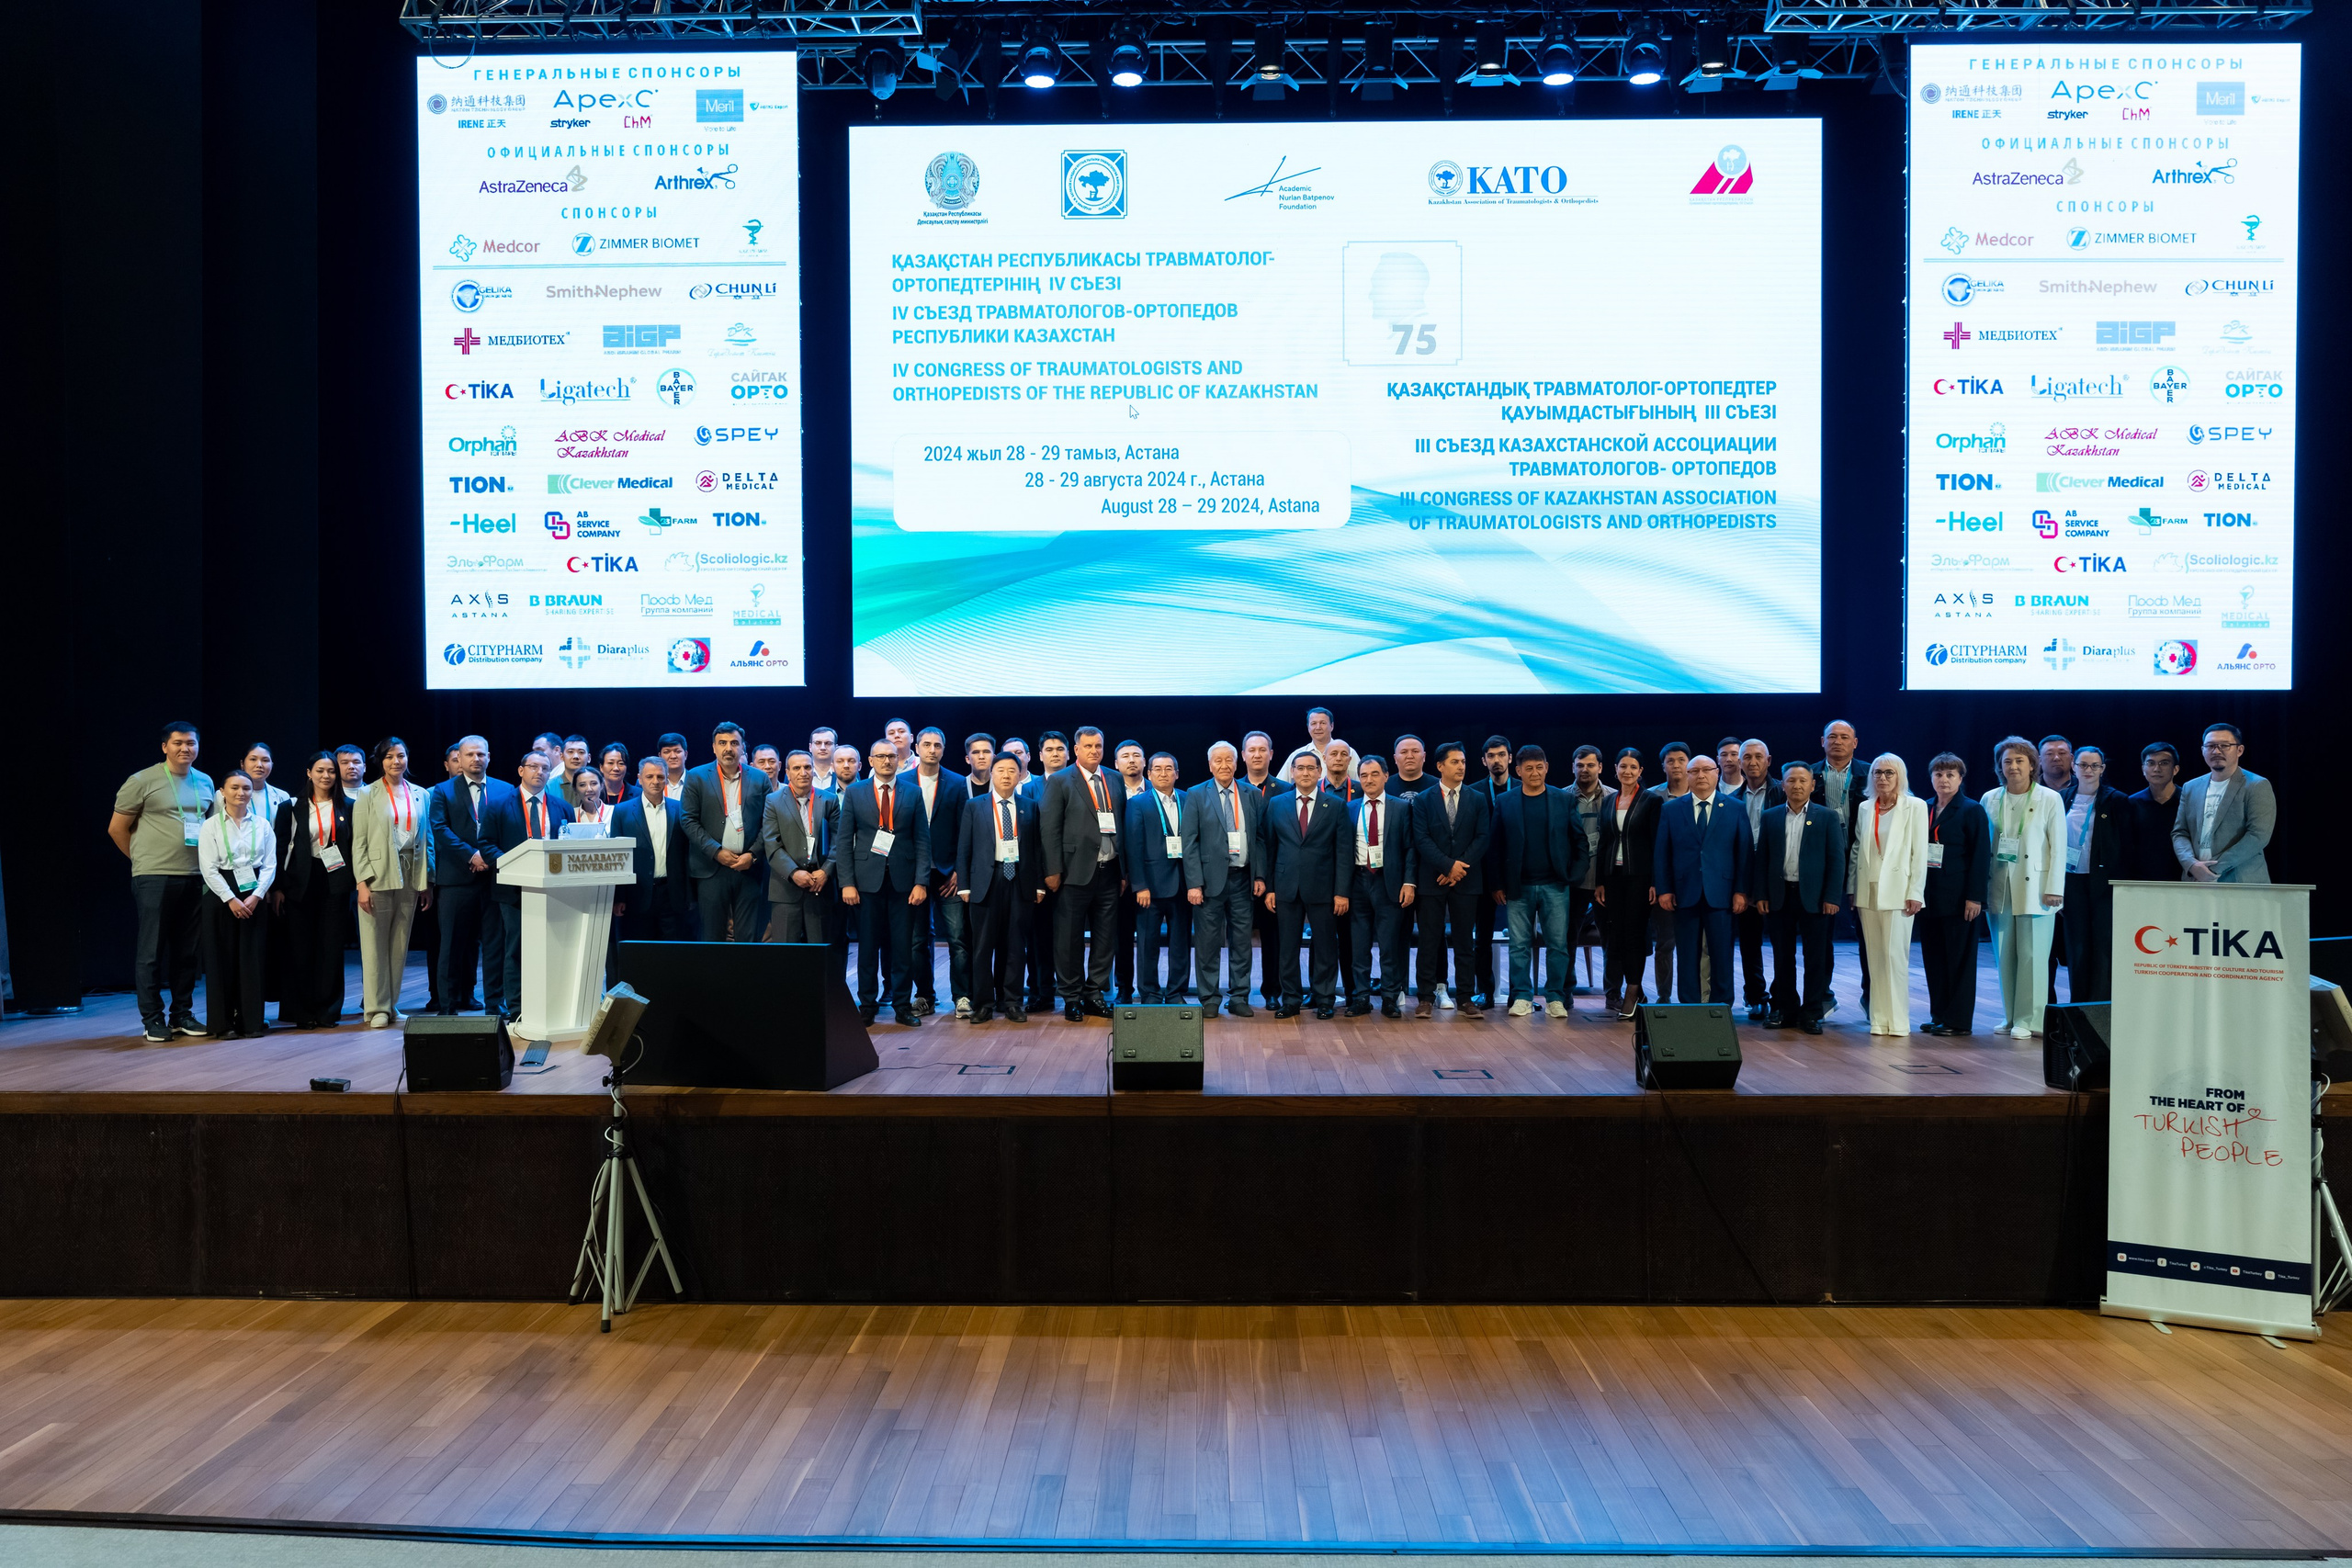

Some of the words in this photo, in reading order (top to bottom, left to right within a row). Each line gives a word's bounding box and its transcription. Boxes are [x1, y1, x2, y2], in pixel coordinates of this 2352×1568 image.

[474, 68, 619, 80] ГЕНЕРАЛЬНЫЕ
[628, 67, 740, 78] СПОНСОРЫ
[451, 95, 525, 108] 纳通科技集团
[704, 97, 736, 114] Meril
[458, 119, 484, 129] IRENE
[487, 119, 505, 128] 正天
[550, 118, 591, 129] stryker
[1982, 138, 2122, 152] ОФИЦИАЛЬНЫЕ
[2132, 138, 2228, 149] СПОНСОРЫ
[480, 180, 568, 193] AstraZeneca
[655, 173, 715, 189] Arthrex
[1467, 166, 1567, 194] KATO
[1973, 173, 2063, 185] AstraZeneca
[2056, 201, 2153, 212] СПОНСОРЫ
[2095, 233, 2143, 243] ZIMMER
[2149, 233, 2197, 243] BIOMET
[483, 240, 540, 253] Medcor
[892, 254, 992, 271] ҚАЗАҚСТАН
[999, 253, 1140, 267] РЕСПУБЛИКАСЫ
[1146, 252, 1274, 265] ТРАВМАТОЛОГ-
[478, 286, 512, 295] GELIKA
[892, 277, 1041, 295] ОРТОПЕДТЕРІНІҢ
[1050, 276, 1066, 290] IV
[1070, 276, 1121, 290] СЪЕЗІ
[893, 306, 909, 320] IV
[914, 306, 972, 322] СЪЕЗД
[976, 303, 1238, 321] ТРАВМАТОЛОГОВ-ОРТОПЕДОВ
[488, 335, 565, 346] МЕДБИОТЕХ
[893, 329, 1009, 344] РЕСПУБЛИКИ
[1014, 328, 1114, 343] КАЗАХСТАН
[1391, 322, 1437, 355] 75
[893, 364, 909, 377] IV
[914, 362, 1005, 377] CONGRESS
[1011, 362, 1032, 376] OF
[1036, 361, 1202, 376] TRAUMATOLOGISTS
[1207, 360, 1242, 375] AND
[2226, 367, 2282, 380] САЙГАК
[540, 378, 630, 405] Ligatech
[661, 383, 693, 393] BAYER
[893, 386, 1021, 400] ORTHOPEDISTS
[1026, 386, 1047, 400] OF
[1053, 386, 1085, 400] THE
[1091, 385, 1173, 400] REPUBLIC
[1179, 385, 1200, 399] OF
[1206, 384, 1317, 399] KAZAKHSTAN
[1387, 382, 1530, 400] ҚАЗАҚСТАНДЫҚ
[1533, 381, 1776, 398] ТРАВМАТОЛОГ-ОРТОПЕДТЕР
[2225, 384, 2283, 398] ОРТО
[1502, 405, 1697, 423] ҚАУЫМДАСТЫҒЫНЫҢ
[1705, 405, 1720, 419] III
[1725, 405, 1776, 419] СЪЕЗІ
[716, 428, 778, 441] SPEY
[2105, 428, 2157, 439] Medical
[1416, 439, 1430, 453] III
[1436, 438, 1495, 456] СЪЕЗД
[1499, 434, 1647, 452] КАЗАХСТАНСКОЙ
[1653, 437, 1776, 455] АССОЦИАЦИИ
[1937, 434, 2006, 453] Orphan
[2047, 445, 2120, 456] Kazakhstan
[924, 446, 962, 461] 2024
[967, 449, 1001, 460] жыл
[1007, 446, 1024, 460] 28
[1042, 446, 1059, 460] 29
[1065, 448, 1120, 462] тамыз,
[1125, 445, 1179, 459] Астана
[1510, 461, 1666, 476] ТРАВМАТОЛОГОВ-
[1672, 461, 1776, 479] ОРТОПЕДОВ
[2215, 473, 2270, 481] DELTA
[1025, 472, 1044, 487] 28
[1060, 472, 1079, 487] 29
[1084, 475, 1142, 491] августа
[1148, 471, 1186, 486] 2024
[1192, 475, 1205, 489] г.,
[1210, 471, 1264, 486] Астана
[1936, 473, 1993, 491] TION
[2058, 475, 2105, 488] Clever
[2108, 477, 2164, 488] Medical
[1400, 492, 1415, 506] III
[1420, 492, 1512, 506] CONGRESS
[1518, 491, 1540, 505] OF
[1544, 491, 1656, 505] KAZAKHSTAN
[1663, 491, 1777, 505] ASSOCIATION
[1102, 499, 1153, 517] August
[1159, 498, 1177, 513] 28
[1198, 498, 1216, 513] 29
[1222, 498, 1263, 515] 2024,
[1269, 498, 1319, 513] Astana
[1409, 516, 1430, 530] OF
[1437, 515, 1601, 530] TRAUMATOLOGISTS
[1607, 514, 1642, 528] AND
[1647, 514, 1777, 529] ORTHOPEDISTS
[2188, 553, 2278, 568] Scoliologic.kz
[529, 595, 540, 606] B
[546, 594, 602, 606] BRAUN
[469, 645, 542, 655] CITYPHARM
[568, 853, 629, 863] NAZARBAYEV
[568, 863, 625, 872] UNIVERSITY
[2184, 922, 2283, 959] TİKA
[2206, 1088, 2245, 1100] FROM
[2150, 1096, 2175, 1108] THE
[2177, 1098, 2223, 1112] HEART
[2226, 1102, 2245, 1113] OF
[2133, 1111, 2242, 1138] TURKISH
[2181, 1136, 2283, 1167] PEOPLE
